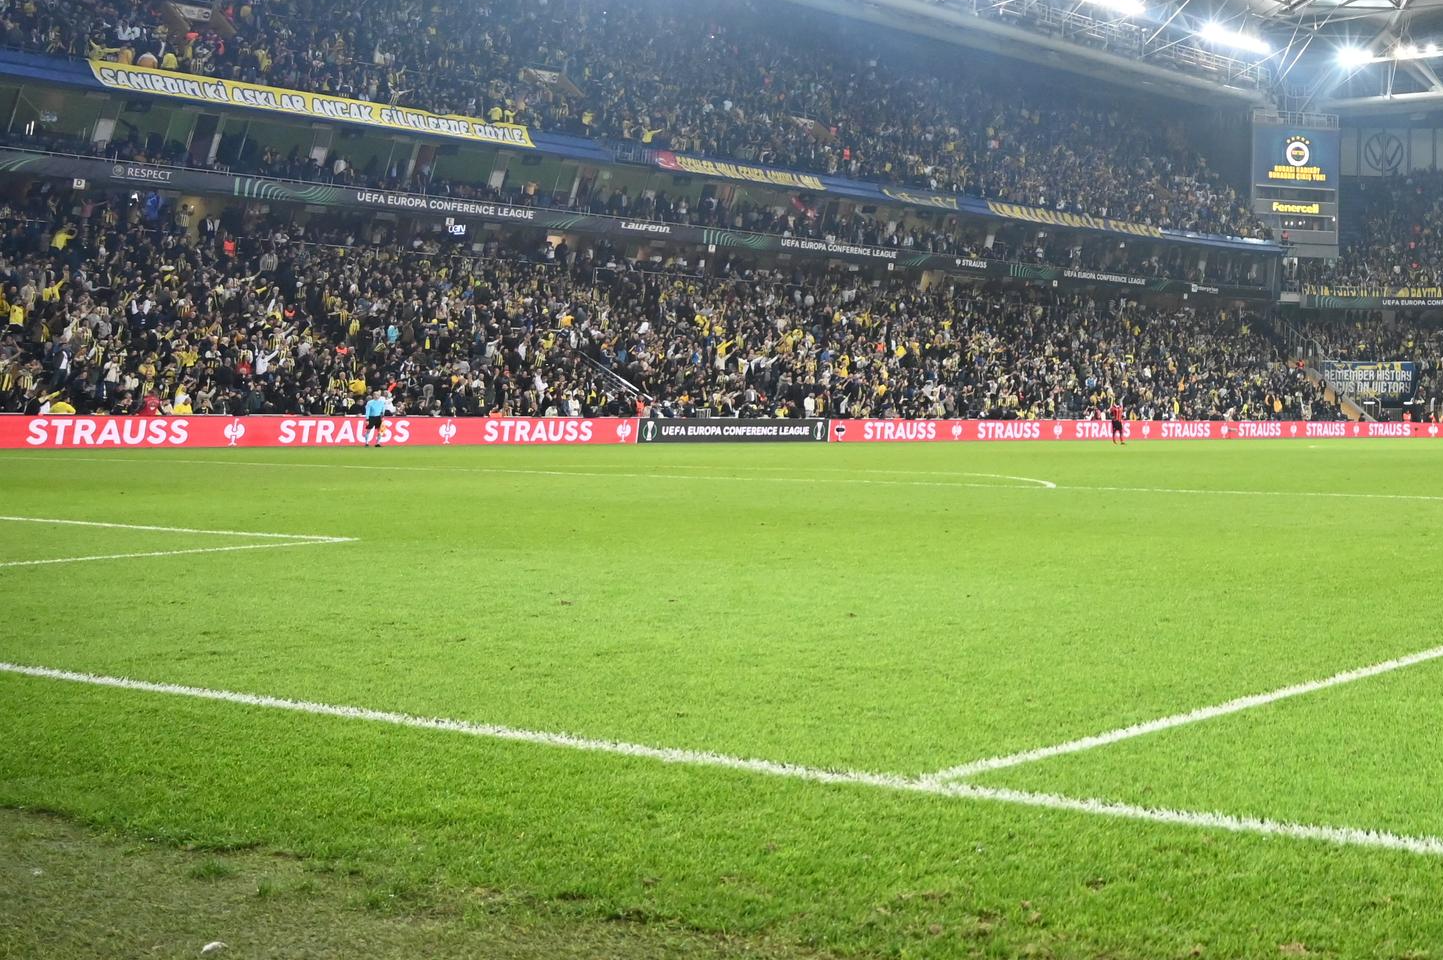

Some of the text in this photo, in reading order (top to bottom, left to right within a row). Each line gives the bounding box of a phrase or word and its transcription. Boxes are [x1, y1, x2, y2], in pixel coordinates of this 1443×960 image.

[127, 167, 172, 180] RESPECT
[357, 192, 534, 220] UEFA EUROPA CONFERENCE LEAGUE
[1272, 201, 1319, 214] Fenercell
[621, 221, 672, 234] Laufenn
[781, 239, 896, 258] UEFA EUROPA CONFERENCE LEAGUE
[961, 259, 987, 268] STRAUSS
[1078, 271, 1096, 279] EUROPA
[1097, 273, 1127, 283] CONFERENCE
[1128, 277, 1145, 285] LEAGUE
[1325, 369, 1412, 381] REMEMBER HISTORY
[26, 419, 189, 445] STRAUSS
[484, 420, 592, 442] STRAUSS
[662, 426, 809, 435] UEFA EUROPA CONFERENCE LEAGUE
[864, 422, 936, 439] STRAUSS
[977, 422, 1040, 438] STRAUSS
[1161, 422, 1210, 437] STRAUSS
[1238, 423, 1281, 437] STRAUSS
[1306, 423, 1345, 436] STRAUSS
[1368, 424, 1411, 436] STRAUSS
